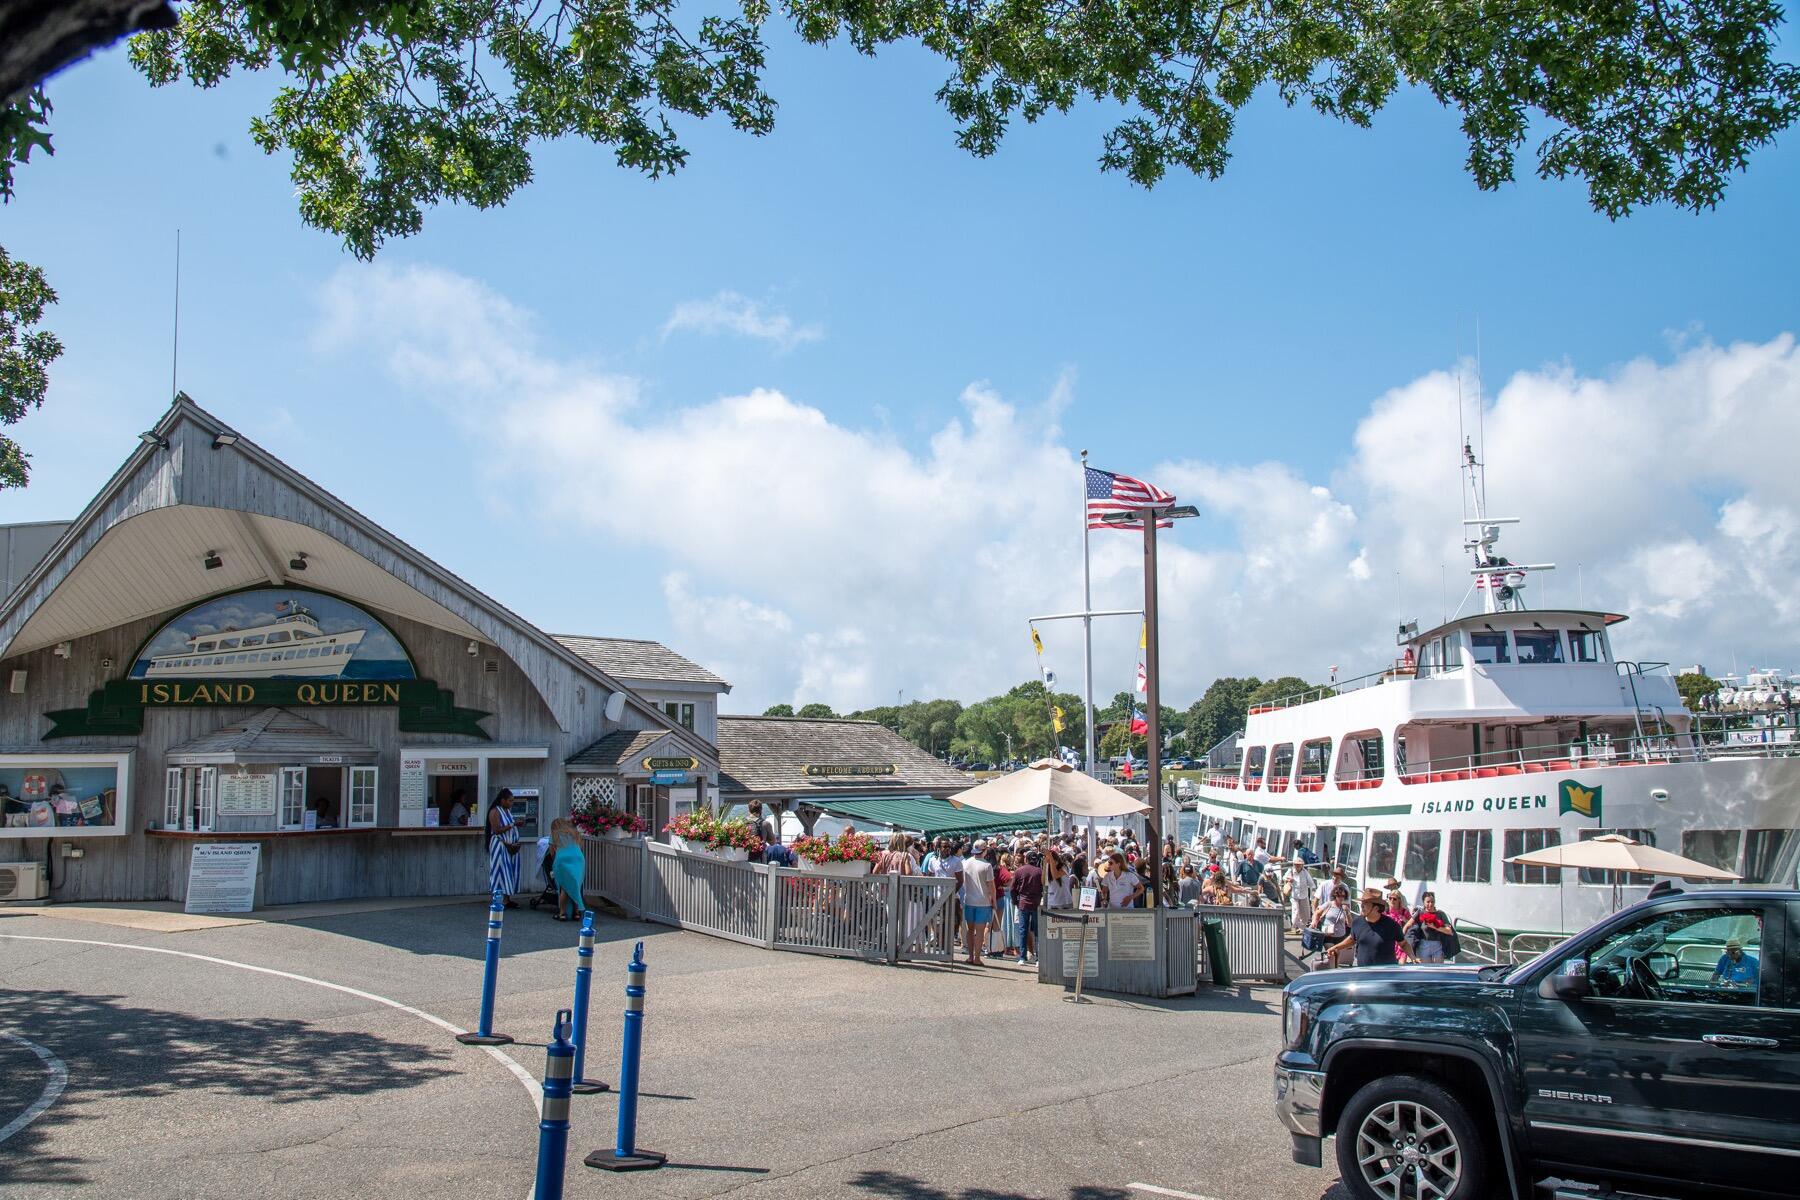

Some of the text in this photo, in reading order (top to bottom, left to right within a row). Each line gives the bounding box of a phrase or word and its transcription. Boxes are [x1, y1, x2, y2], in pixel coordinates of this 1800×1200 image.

[140, 683, 400, 705] ISLAND QUEEN
[821, 766, 883, 774] WELCOME ABOARD
[1422, 795, 1546, 813] ISLAND QUEEN
[1538, 1089, 1613, 1104] SIERRA
